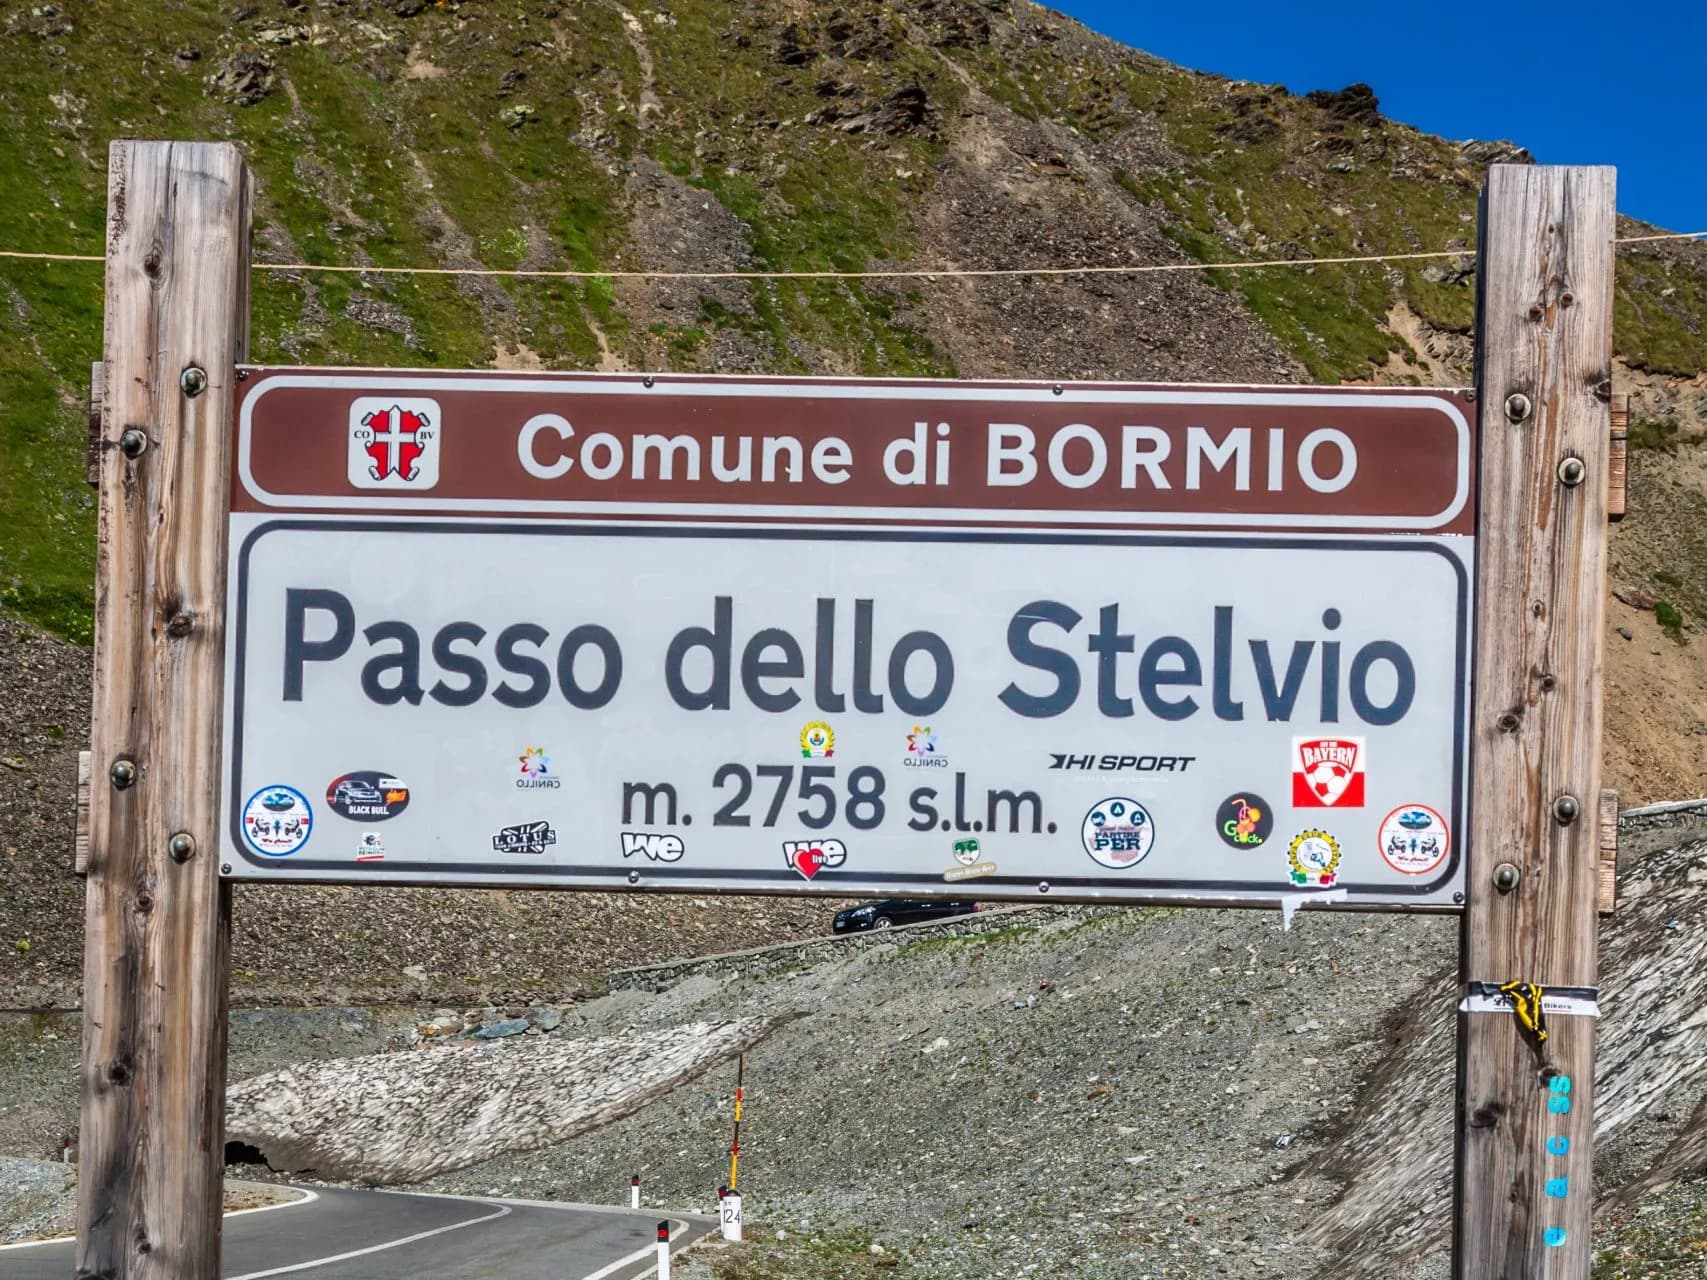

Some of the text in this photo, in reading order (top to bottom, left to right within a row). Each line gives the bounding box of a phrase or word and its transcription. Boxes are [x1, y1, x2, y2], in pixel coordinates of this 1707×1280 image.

[517, 413, 1359, 493] Comune di BORMIO
[282, 587, 1416, 726] Passo dello Stelvio
[1065, 754, 1196, 772] HI SPORT
[1302, 746, 1356, 768] BAYERN
[621, 763, 1058, 834] m. 2758 s.l.m.
[348, 805, 370, 814] BLACK
[494, 831, 556, 846] LOTUS
[1094, 838, 1141, 851] PER
